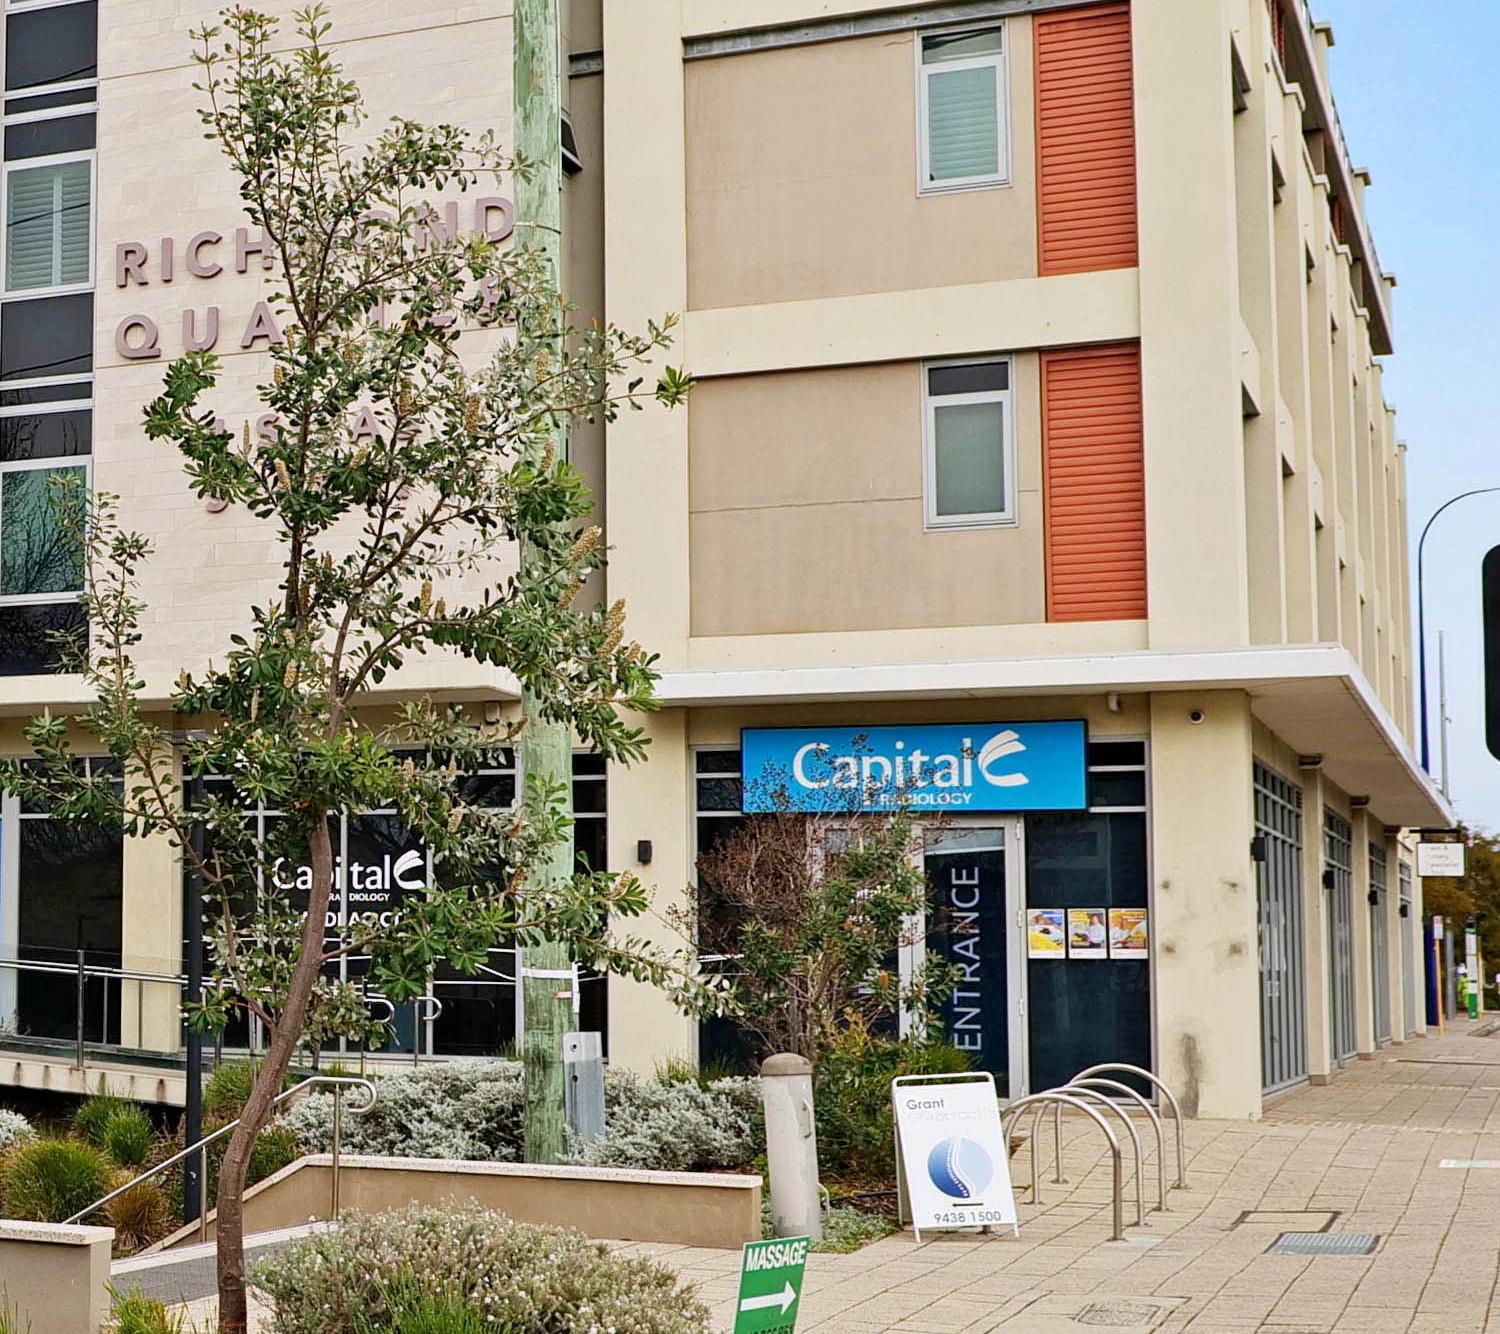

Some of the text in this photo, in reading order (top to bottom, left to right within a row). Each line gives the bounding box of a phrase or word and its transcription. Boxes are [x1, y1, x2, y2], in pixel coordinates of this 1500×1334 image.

[793, 738, 973, 805] Capital
[271, 854, 391, 890] Caital
[951, 866, 983, 1052] ENTRANCE
[906, 1097, 945, 1110] Grant
[934, 1208, 1002, 1225] 9438 1500
[745, 1240, 807, 1272] MASSAGE
